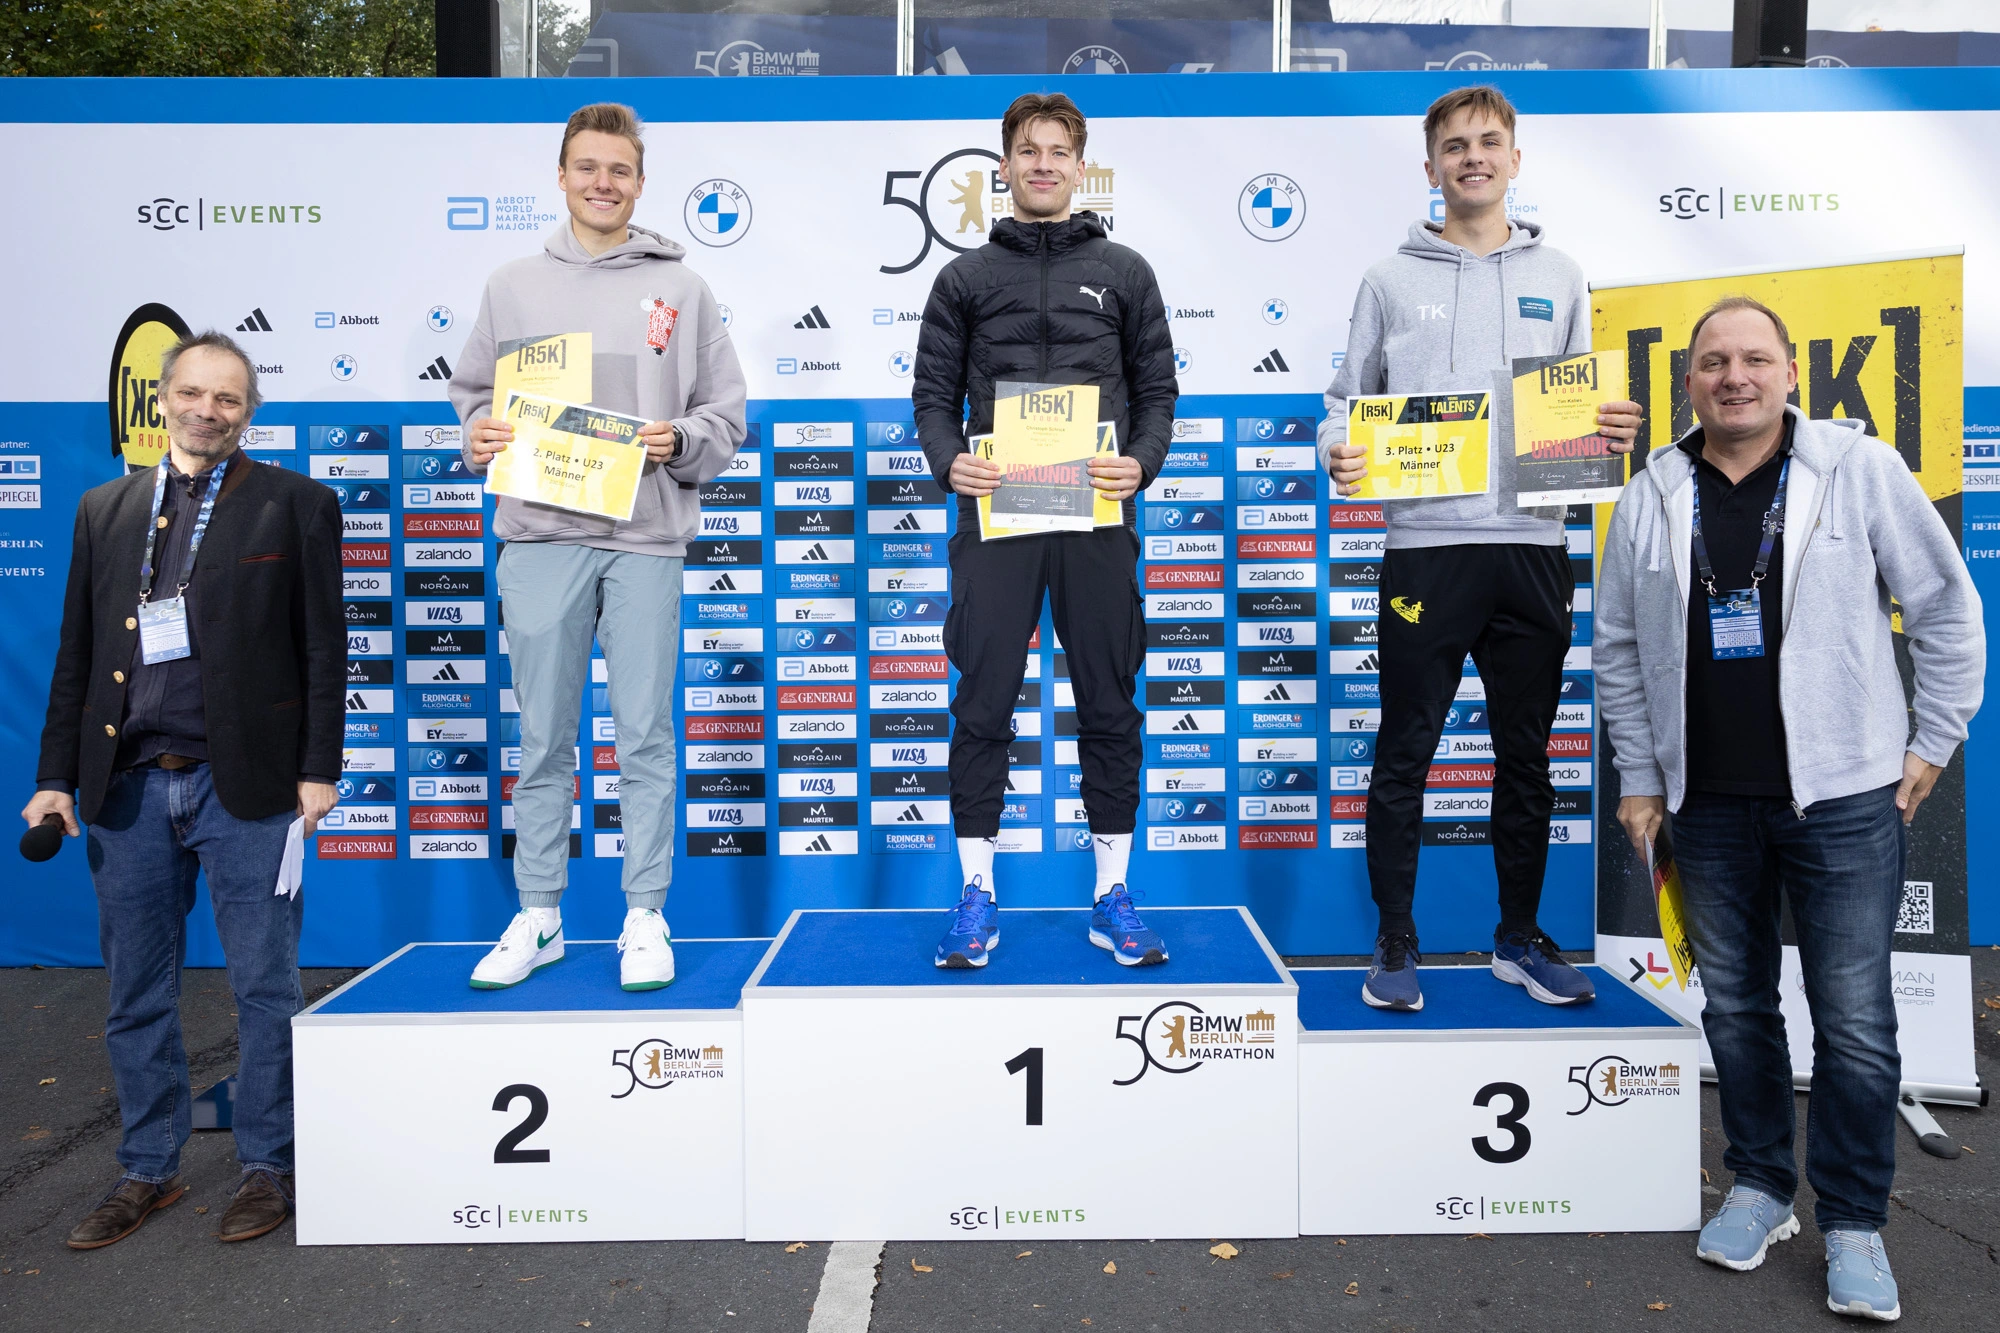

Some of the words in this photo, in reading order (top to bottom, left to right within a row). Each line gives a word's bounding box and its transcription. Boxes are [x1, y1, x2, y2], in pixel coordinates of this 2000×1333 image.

[753, 52, 794, 65] BMW
[753, 67, 795, 75] BERLIN
[1660, 193, 1709, 214] SCC
[1734, 194, 1839, 211] EVENTS
[138, 204, 189, 224] SCC
[214, 206, 321, 223] EVENTS
[1175, 309, 1215, 318] Abbott
[1417, 304, 1446, 320] TK
[339, 316, 379, 324] Abbott
[517, 339, 566, 372] [R5K]
[255, 365, 283, 373] bbott
[801, 362, 841, 370] Abbott
[1540, 358, 1598, 394] [R5K]
[1021, 388, 1073, 422] [R5K]
[1430, 400, 1475, 415] TALENTS
[519, 401, 550, 423] [R5K]
[1362, 402, 1392, 421] [R5K]
[588, 417, 633, 436] TALENTS
[1386, 447, 1395, 455] 3.
[1399, 446, 1422, 455] Platz
[1435, 444, 1454, 453] U23
[1532, 437, 1611, 459] URKUNDE
[533, 448, 542, 458] 2.
[546, 451, 570, 464] Platz
[583, 458, 603, 470] U23
[1256, 458, 1271, 468] EY
[889, 457, 924, 473] VILSA
[1400, 461, 1440, 470] Männer
[329, 466, 344, 476] EY
[544, 466, 586, 482] Männer
[1006, 464, 1081, 485] URKUNDE
[435, 492, 475, 501] Abbott
[797, 487, 832, 503] VILSA
[1164, 489, 1179, 498] EY
[1269, 513, 1309, 522] Abbott
[343, 521, 383, 530] Abbott
[425, 520, 479, 530] GENERALI
[704, 517, 739, 533] VILSA
[883, 543, 922, 552] ERDINGER
[1176, 542, 1217, 552] Abbott
[1258, 541, 1312, 551] GENERALI
[342, 550, 387, 560] ENERALI
[416, 549, 471, 560] zalando
[791, 573, 830, 582] ERDINGER
[1166, 572, 1220, 582] GENERALI
[1250, 570, 1304, 581] zalando
[888, 580, 903, 589] EY
[698, 604, 738, 612] ERDINGER
[1157, 600, 1212, 611] zalando
[428, 607, 462, 623] VILSA
[796, 610, 811, 619] EY
[901, 633, 941, 643] Abbott
[1259, 628, 1294, 643] VILSA
[704, 640, 718, 649] EY
[809, 664, 849, 673] Abbott
[890, 662, 945, 672] GENERALI
[1168, 658, 1202, 674] VILSA
[422, 694, 462, 702] ERDINGER
[716, 694, 757, 703] Abbott
[798, 692, 853, 702] GENERALI
[882, 691, 937, 702] zalando
[1253, 714, 1292, 722] ERDINGER
[1554, 711, 1585, 721] bbott
[706, 723, 760, 733] GENERALI
[790, 721, 845, 732] zalando
[1349, 720, 1364, 729] EY
[427, 730, 442, 739] EY
[1161, 744, 1201, 752] ERDINGER
[698, 751, 752, 762] zalando
[892, 748, 927, 764] VILSA
[1258, 750, 1272, 759] EY
[440, 784, 481, 793] Abbott
[800, 779, 835, 794] VILSA
[1166, 780, 1181, 789] EY
[1270, 804, 1310, 813] Abbott
[1434, 799, 1488, 810] zalando
[348, 814, 389, 823] Abbott
[430, 813, 485, 823] GENERALI
[709, 809, 743, 825] VILSA
[886, 834, 925, 843] ERDINGER
[1179, 833, 1219, 843] Abbott
[1259, 832, 1314, 842] GENERALI
[338, 842, 393, 852] GENERALI
[422, 841, 477, 852] zalando
[1893, 987, 1934, 997] ACES
[1190, 1016, 1242, 1032] BMW
[1190, 1032, 1243, 1044] BERLIN
[664, 1048, 701, 1060] BMW
[1189, 1048, 1274, 1059] MARATHON
[664, 1061, 702, 1069] BERLIN
[664, 1070, 723, 1078] MARATHON
[1621, 1065, 1657, 1077] BMW
[1004, 1048, 1043, 1125] 1
[1620, 1088, 1680, 1096] MARATHON
[492, 1084, 550, 1164] 2
[1471, 1082, 1531, 1163] 3
[1436, 1199, 1474, 1217] SCC
[1492, 1200, 1571, 1214] EVENTS
[453, 1208, 491, 1225] SCC
[509, 1209, 588, 1223] EVENTS
[950, 1209, 988, 1227] SCC
[1006, 1209, 1085, 1223] EVENTS
